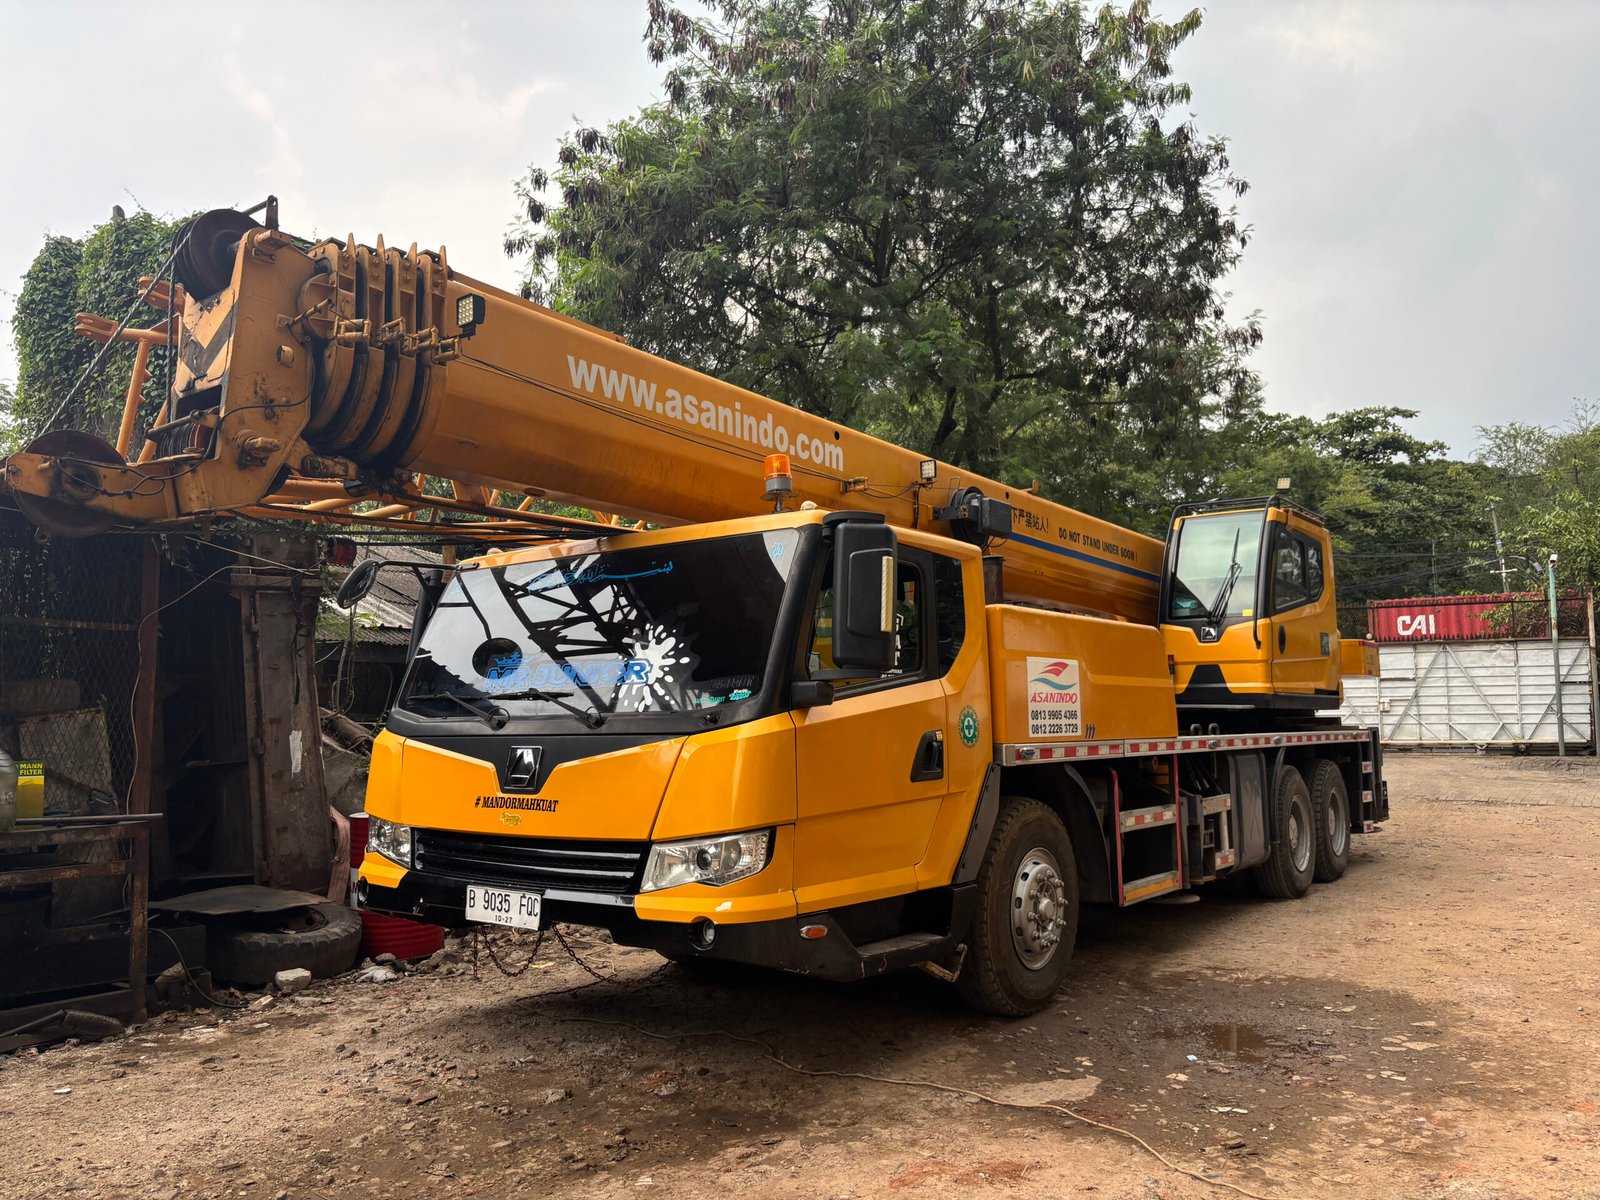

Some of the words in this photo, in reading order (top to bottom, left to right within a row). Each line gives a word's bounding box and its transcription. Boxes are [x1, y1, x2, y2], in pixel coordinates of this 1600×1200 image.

[567, 354, 844, 472] www.asanindo.com
[1058, 527, 1067, 540] DO
[1069, 532, 1080, 545] NOT
[1082, 534, 1101, 550] STAND
[1101, 541, 1119, 556] UNDER
[1397, 614, 1435, 636] CAI
[1030, 691, 1078, 704] ASANINDO
[1031, 709, 1046, 720] 0813
[1048, 709, 1062, 720] 9905
[1031, 723, 1047, 734] 0812
[1064, 723, 1079, 733] 3729
[468, 889, 476, 908] B
[483, 890, 511, 913] 9035
[519, 894, 539, 917] FQC
